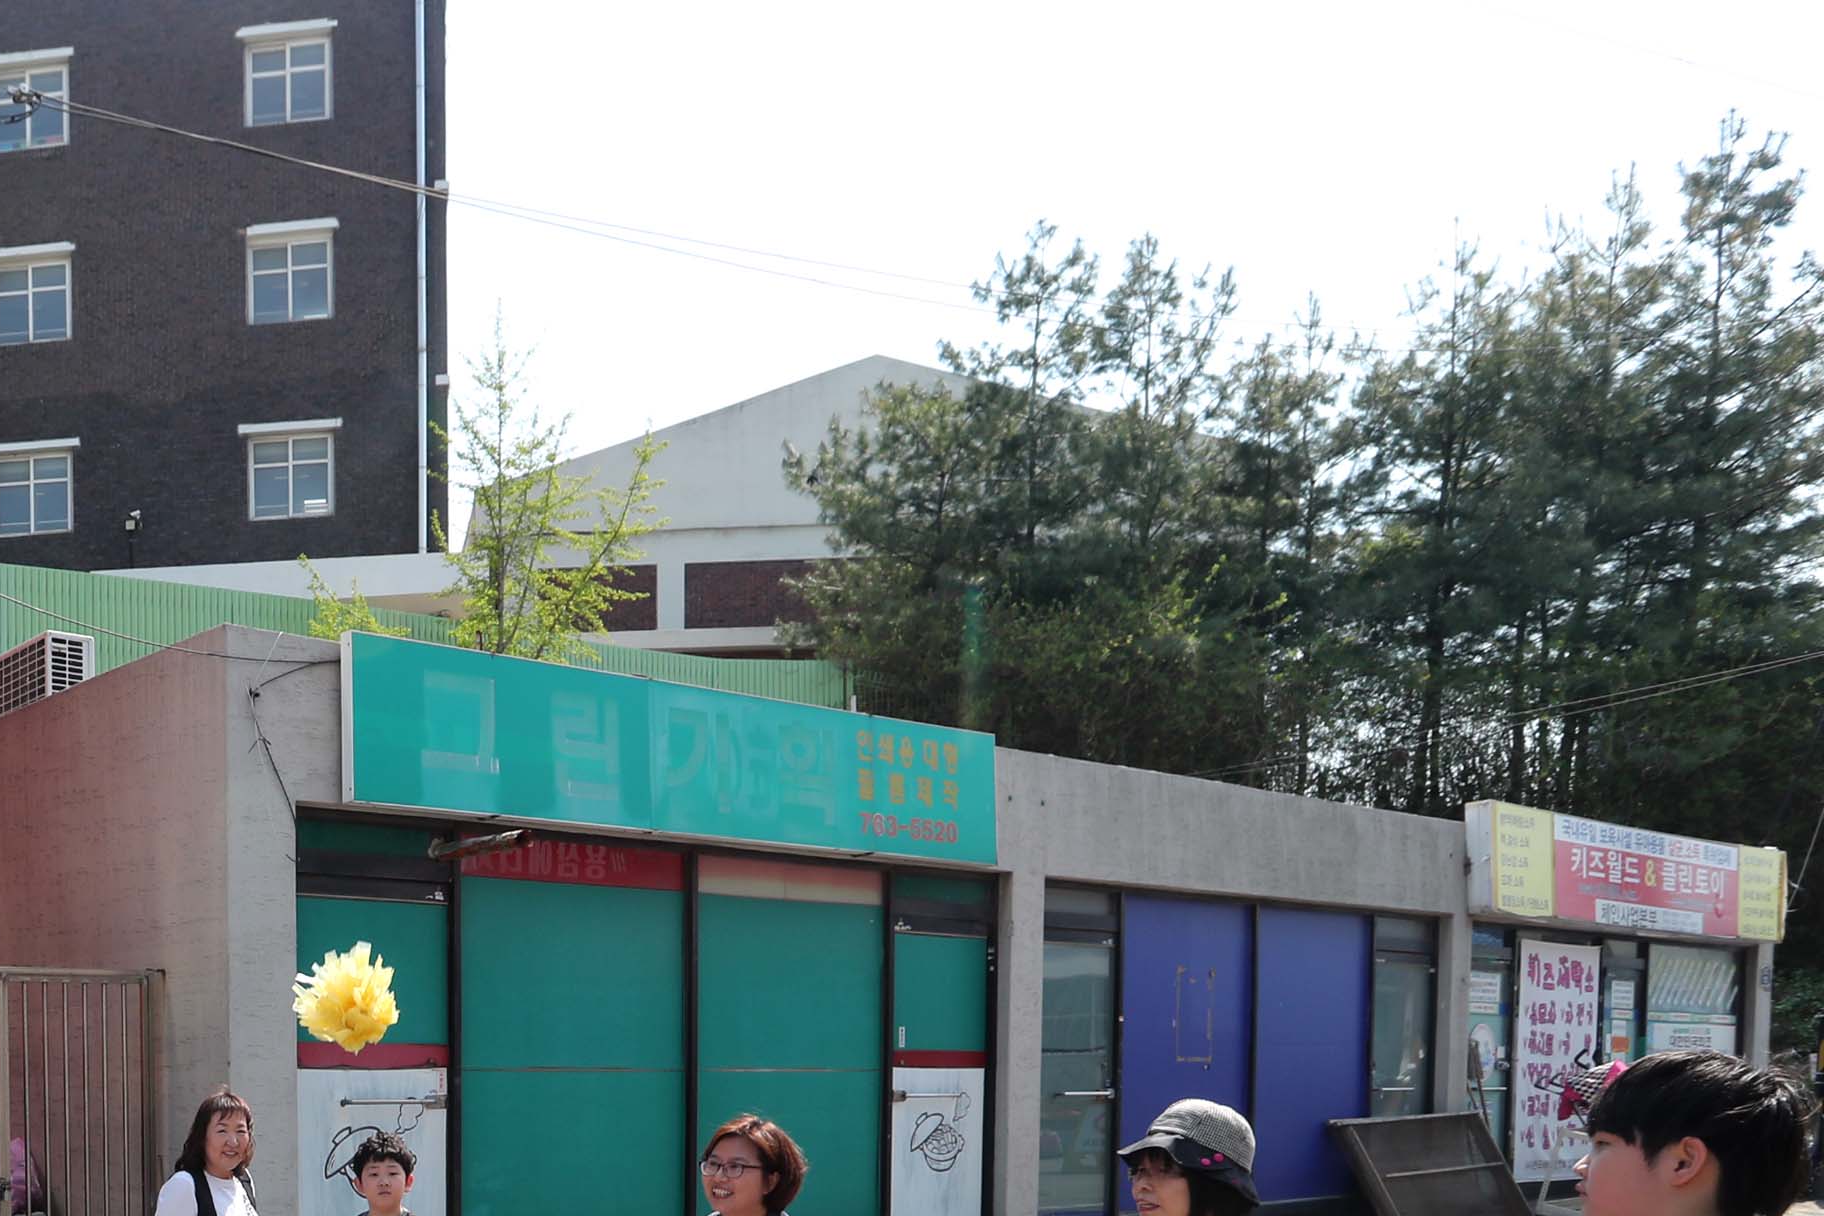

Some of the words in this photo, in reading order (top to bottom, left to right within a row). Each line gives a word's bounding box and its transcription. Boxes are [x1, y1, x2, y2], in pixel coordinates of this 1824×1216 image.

[859, 813, 959, 844] 763-5520
[1561, 818, 1597, 843] 국내유일
[1570, 847, 1641, 885] 키즈월드
[1644, 861, 1657, 887] &
[1662, 859, 1726, 899] 클린토이
